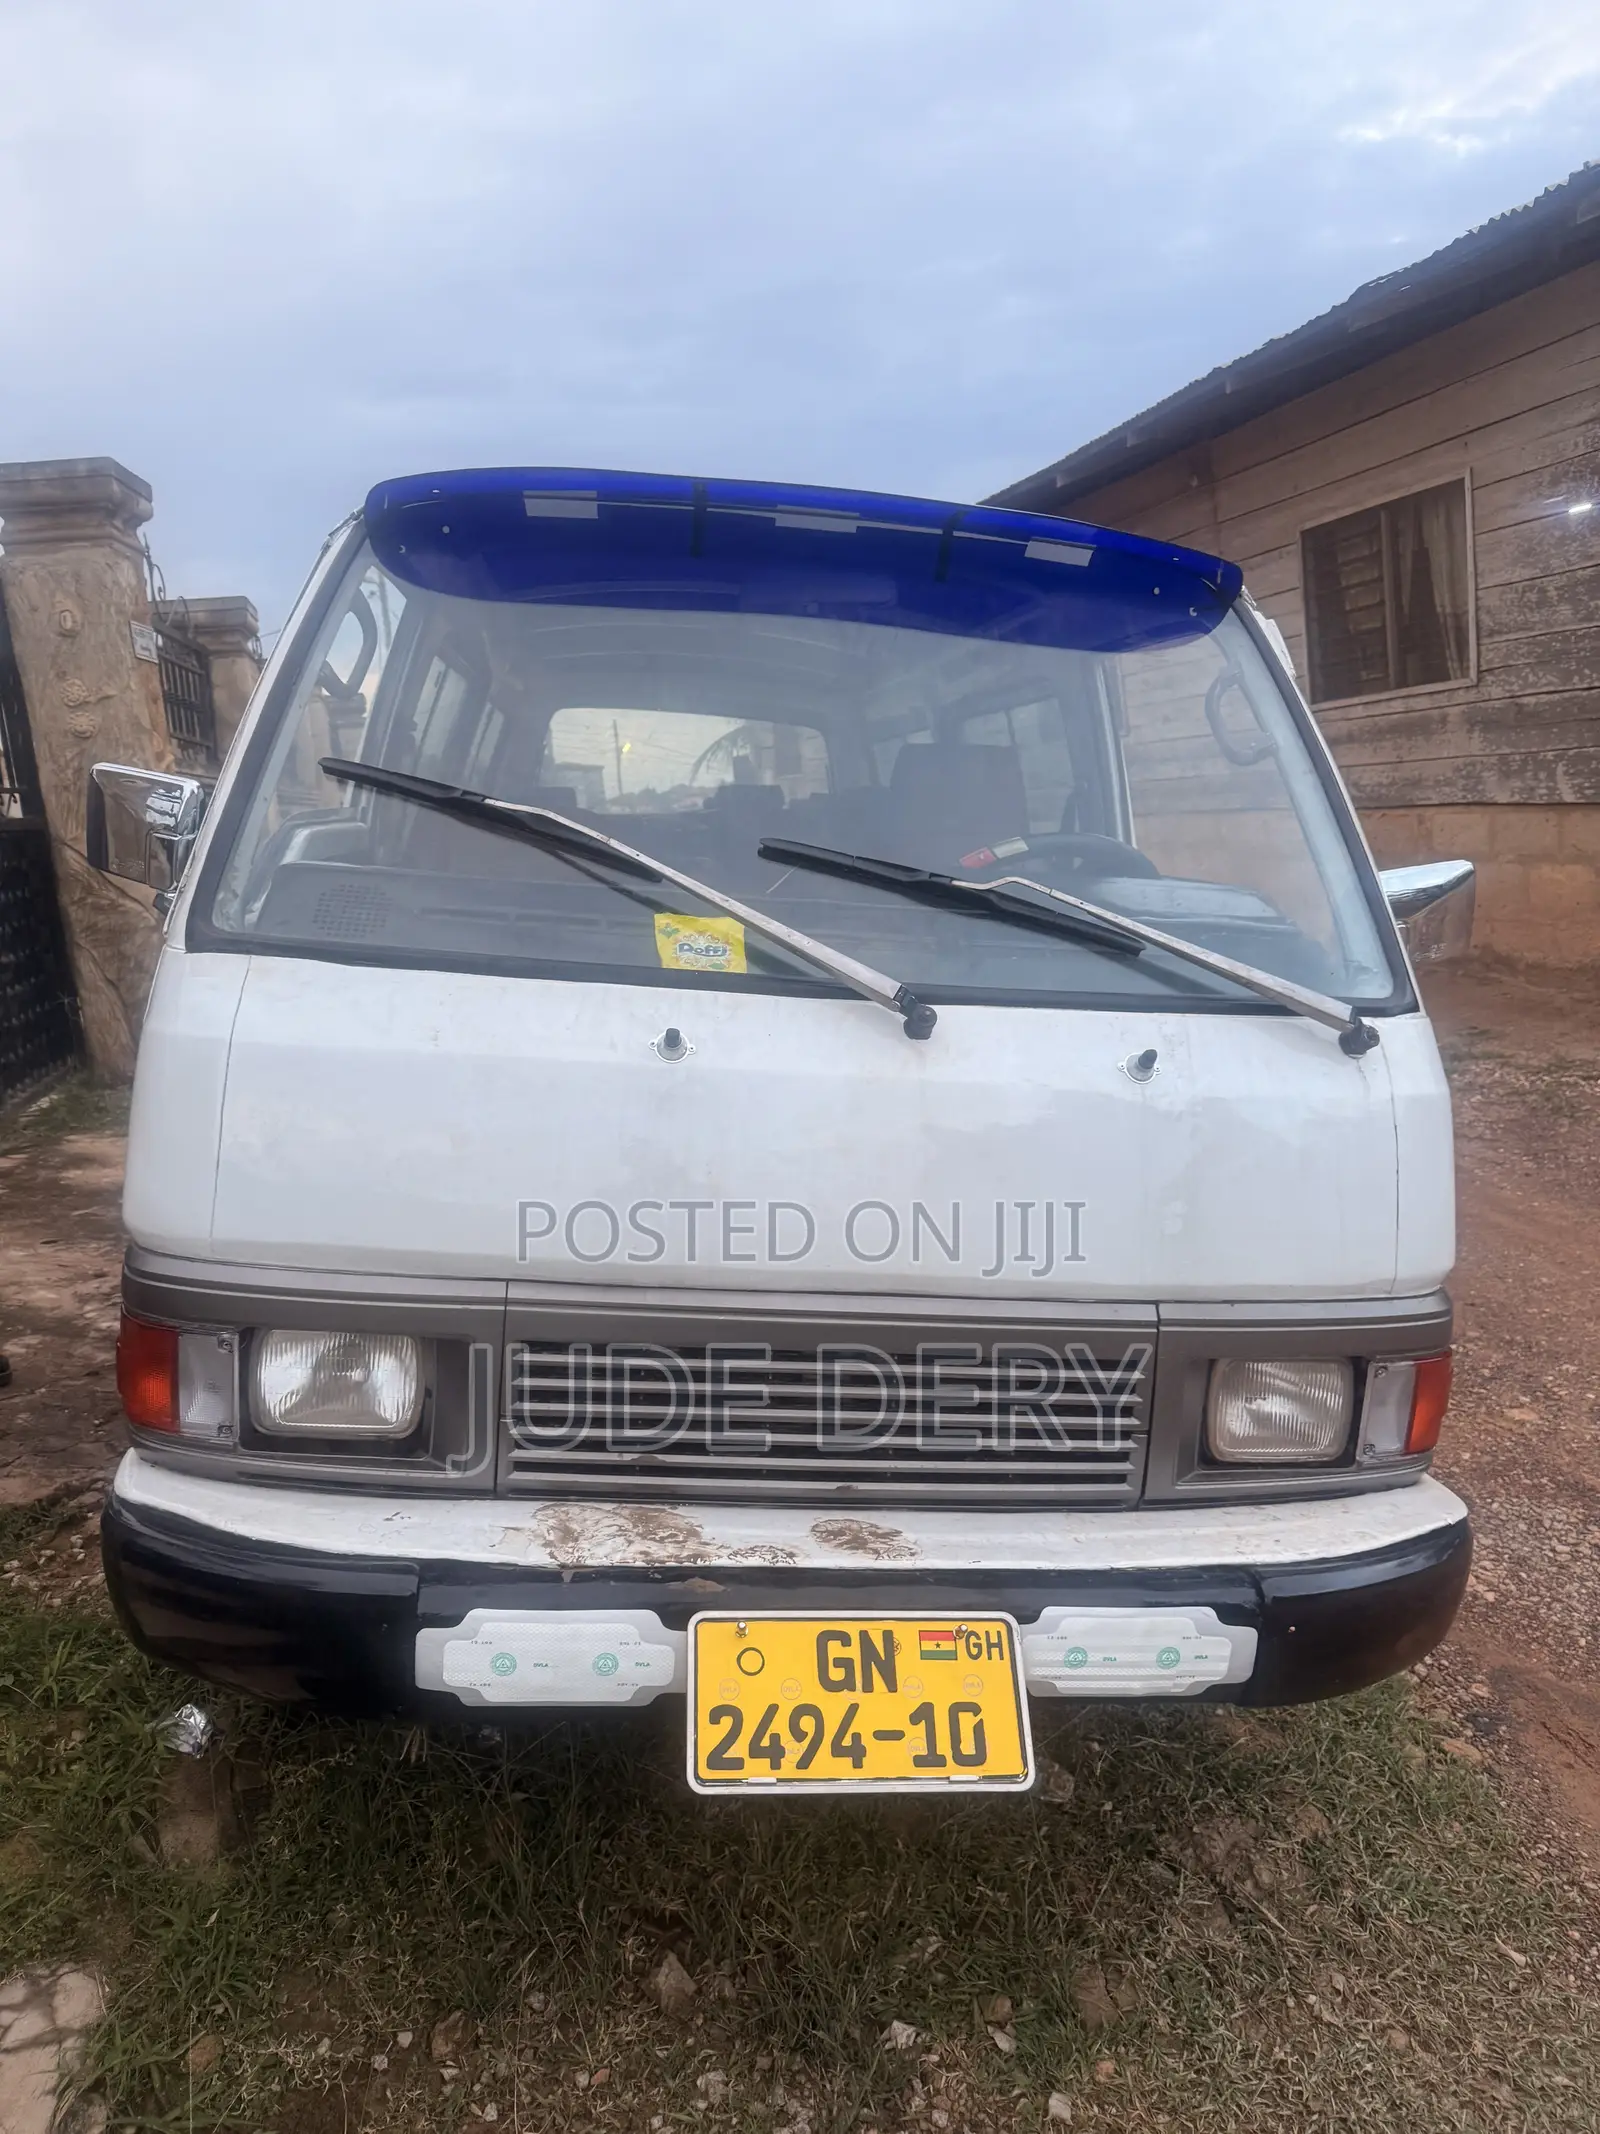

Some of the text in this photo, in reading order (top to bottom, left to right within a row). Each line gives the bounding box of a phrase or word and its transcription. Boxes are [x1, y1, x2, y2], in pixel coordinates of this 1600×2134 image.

[815, 1629, 898, 1693] GN
[964, 1629, 1005, 1661] GH
[706, 1701, 988, 1771] 2494-10
